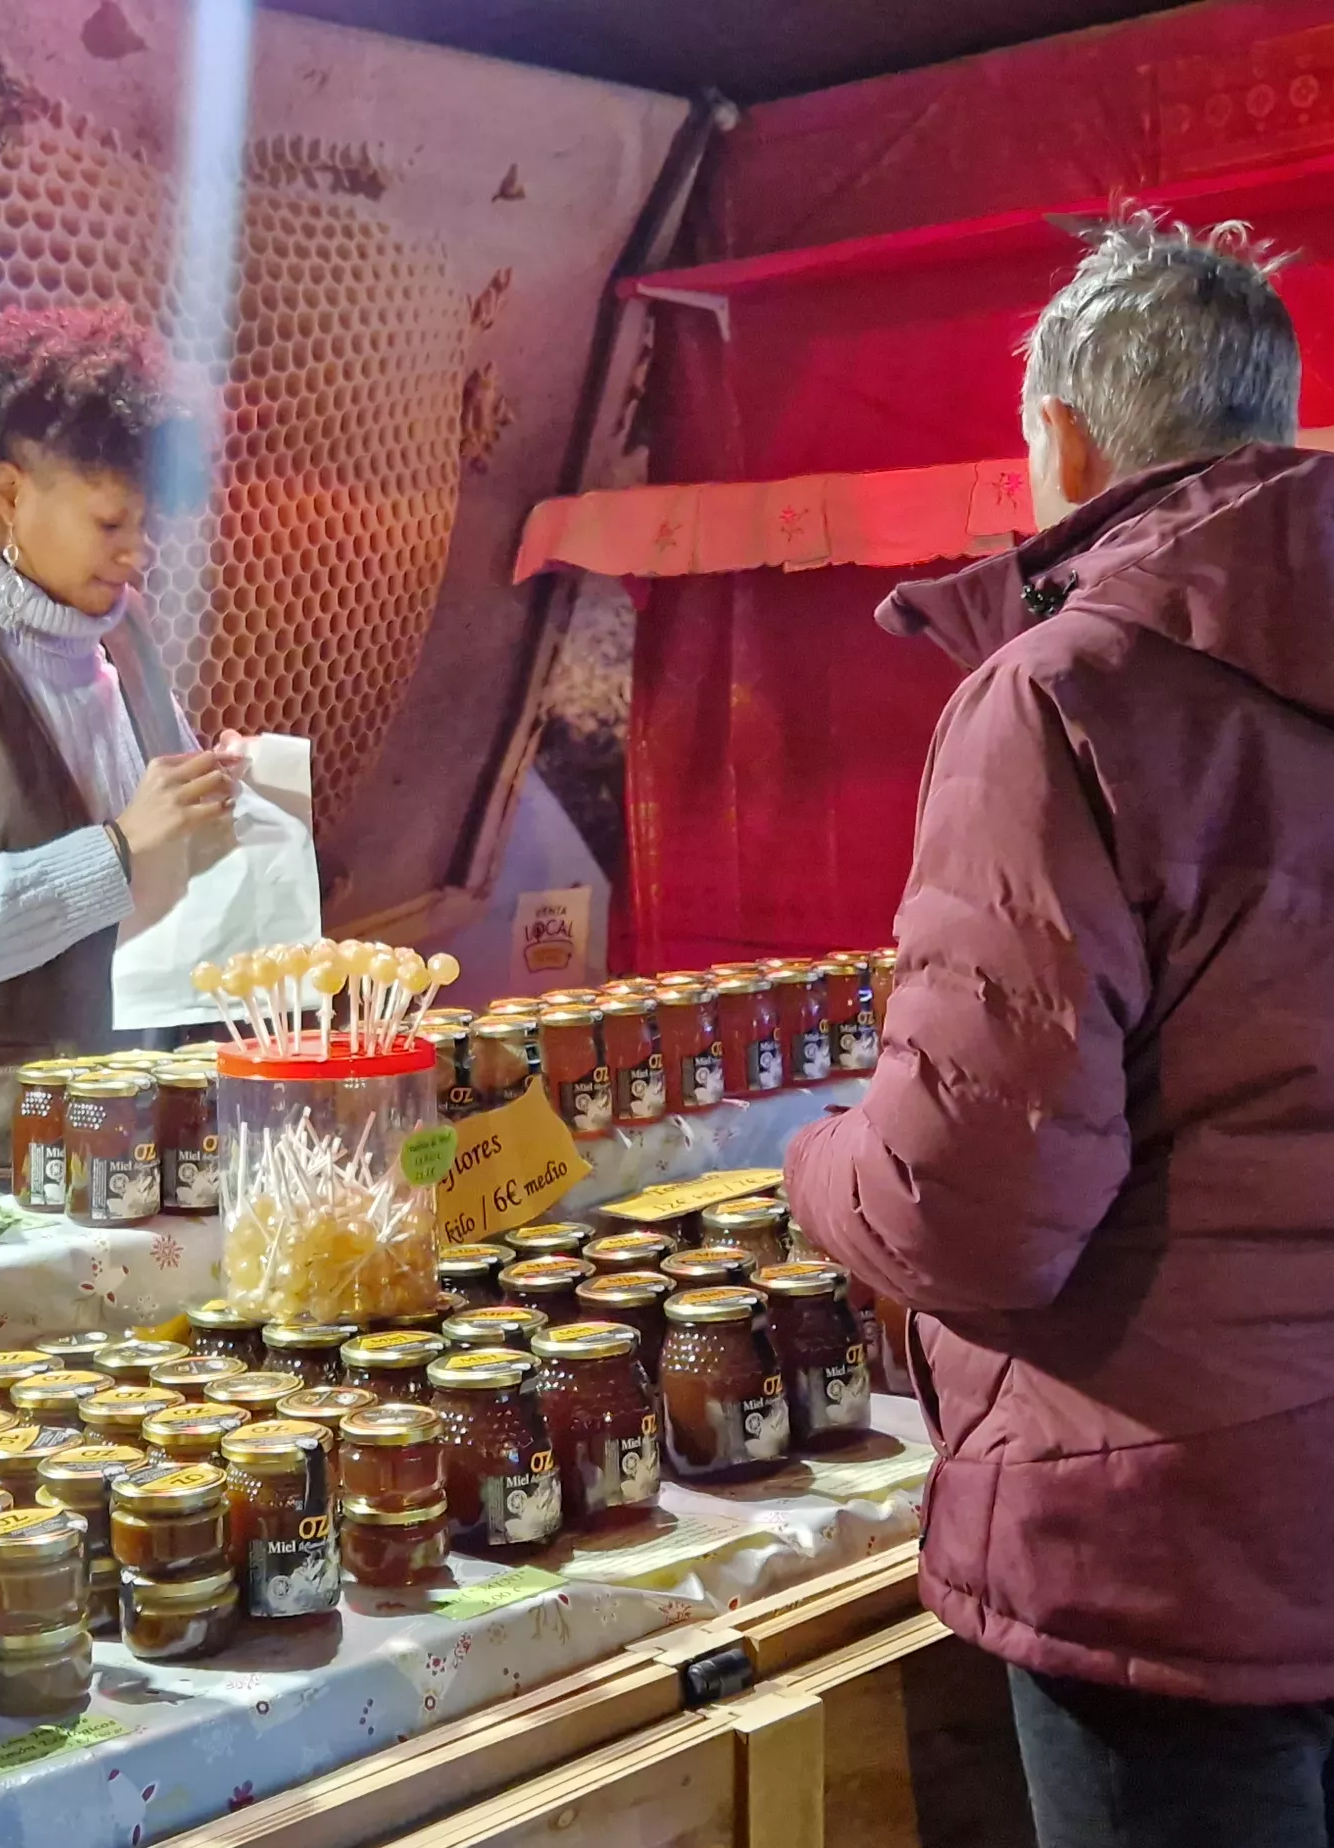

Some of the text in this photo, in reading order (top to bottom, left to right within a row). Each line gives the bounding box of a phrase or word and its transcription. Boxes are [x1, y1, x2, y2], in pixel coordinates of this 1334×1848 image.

[525, 919, 573, 942] LOCAL
[450, 1087, 474, 1103] OZ
[46, 1146, 65, 1158] Mie
[135, 1143, 157, 1161] OZ
[203, 1135, 218, 1152] O
[178, 1150, 201, 1161] Miel
[109, 1160, 133, 1173] Miel
[444, 1212, 476, 1245] kilo
[493, 1178, 523, 1213] 6€
[523, 1159, 568, 1197] medio
[845, 1343, 865, 1364] OZ
[826, 1364, 847, 1379] Miel
[763, 1373, 784, 1396] OZ
[743, 1397, 765, 1412] Miel
[621, 1437, 642, 1452] Miel
[530, 1449, 555, 1474] OZ
[506, 1472, 530, 1490] Miel
[299, 1514, 331, 1541] OZ
[268, 1540, 297, 1554] Miel
